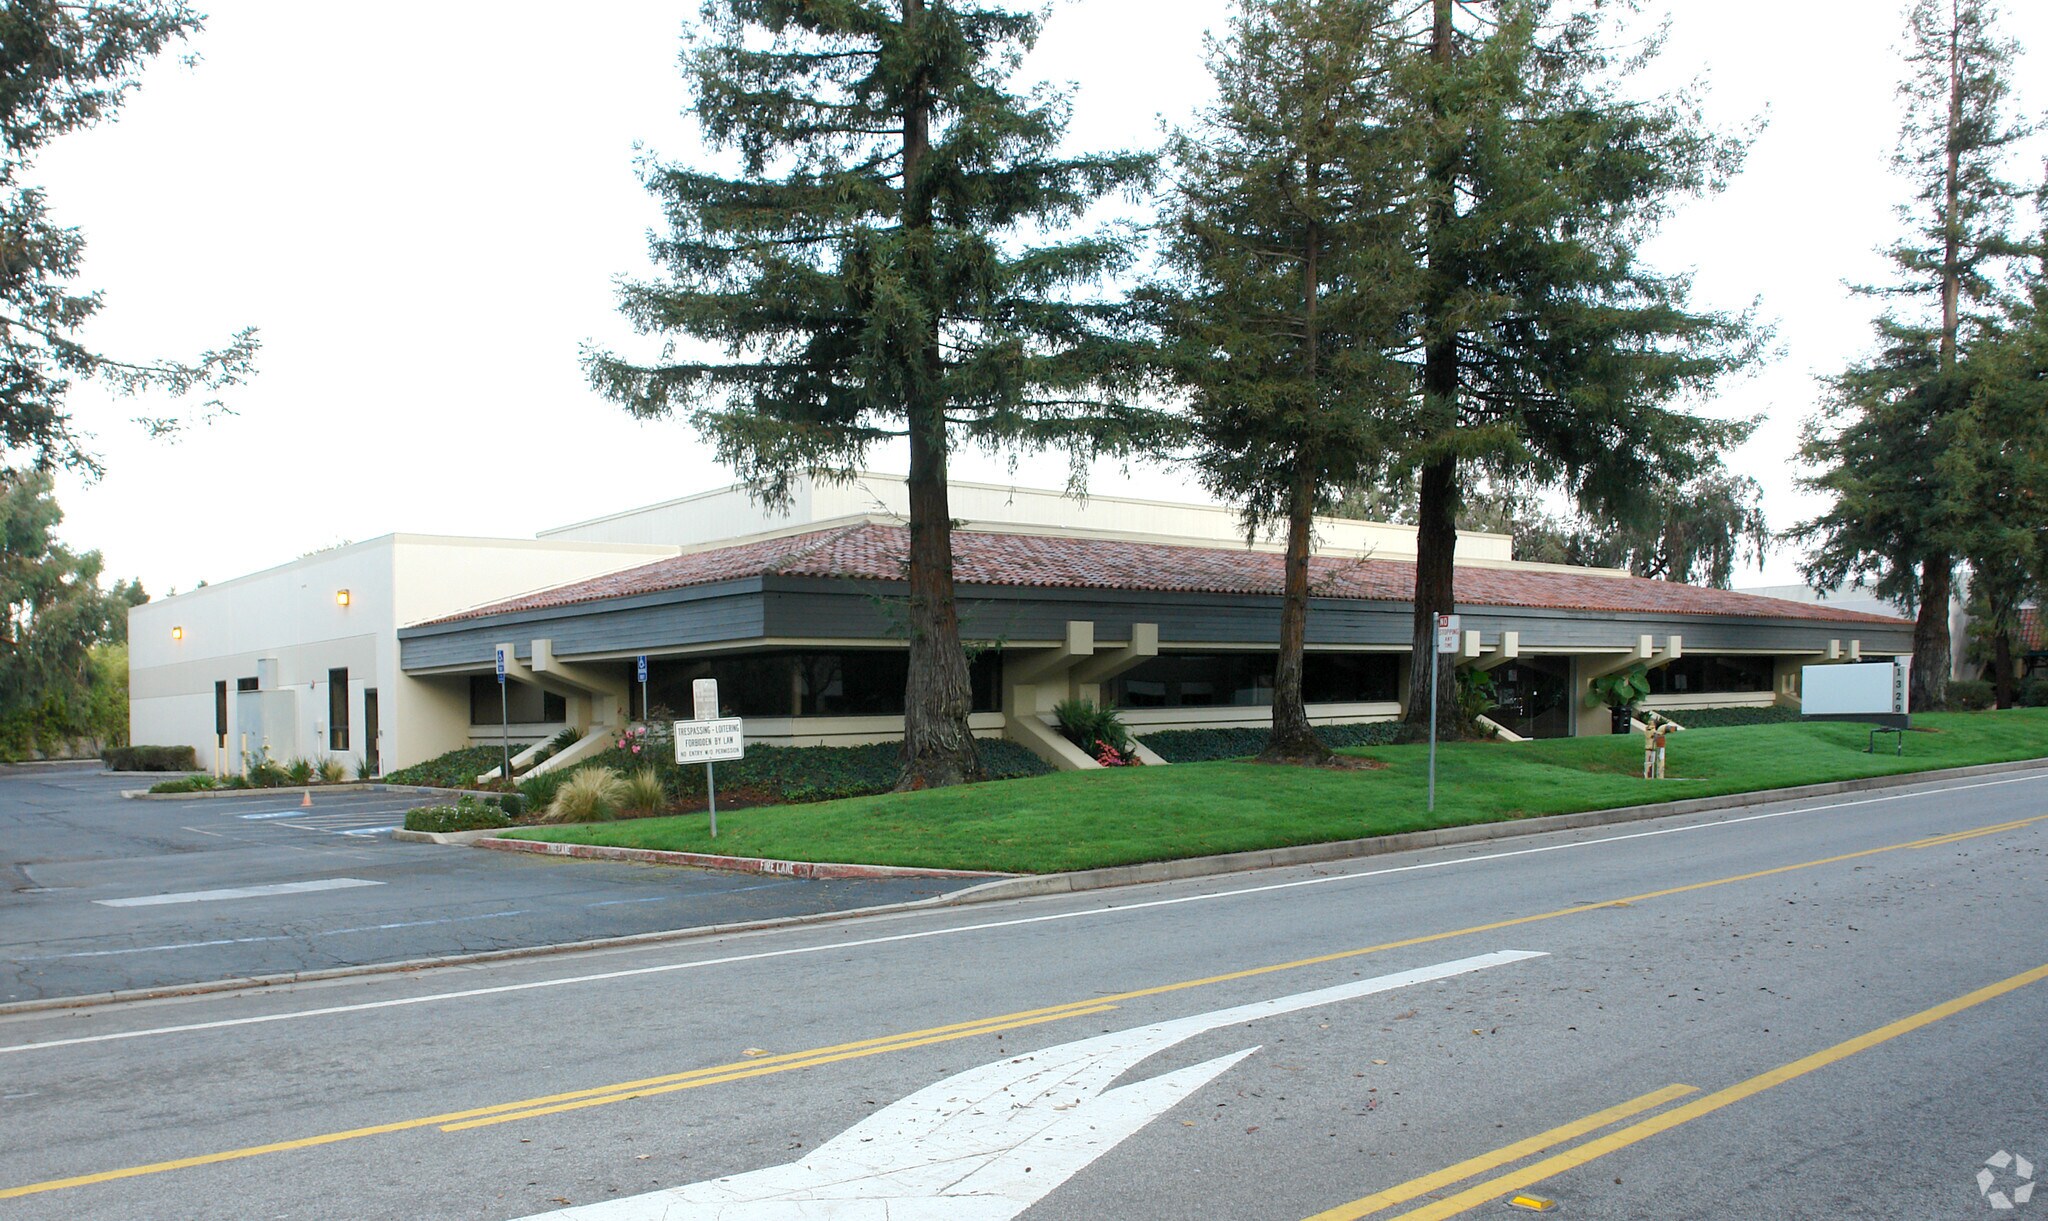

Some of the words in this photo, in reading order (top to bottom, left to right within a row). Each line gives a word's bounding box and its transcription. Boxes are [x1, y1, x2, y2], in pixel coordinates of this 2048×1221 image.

[1894, 668, 1902, 712] 1329
[760, 860, 775, 872] FIRE
[776, 862, 794, 874] LANE
